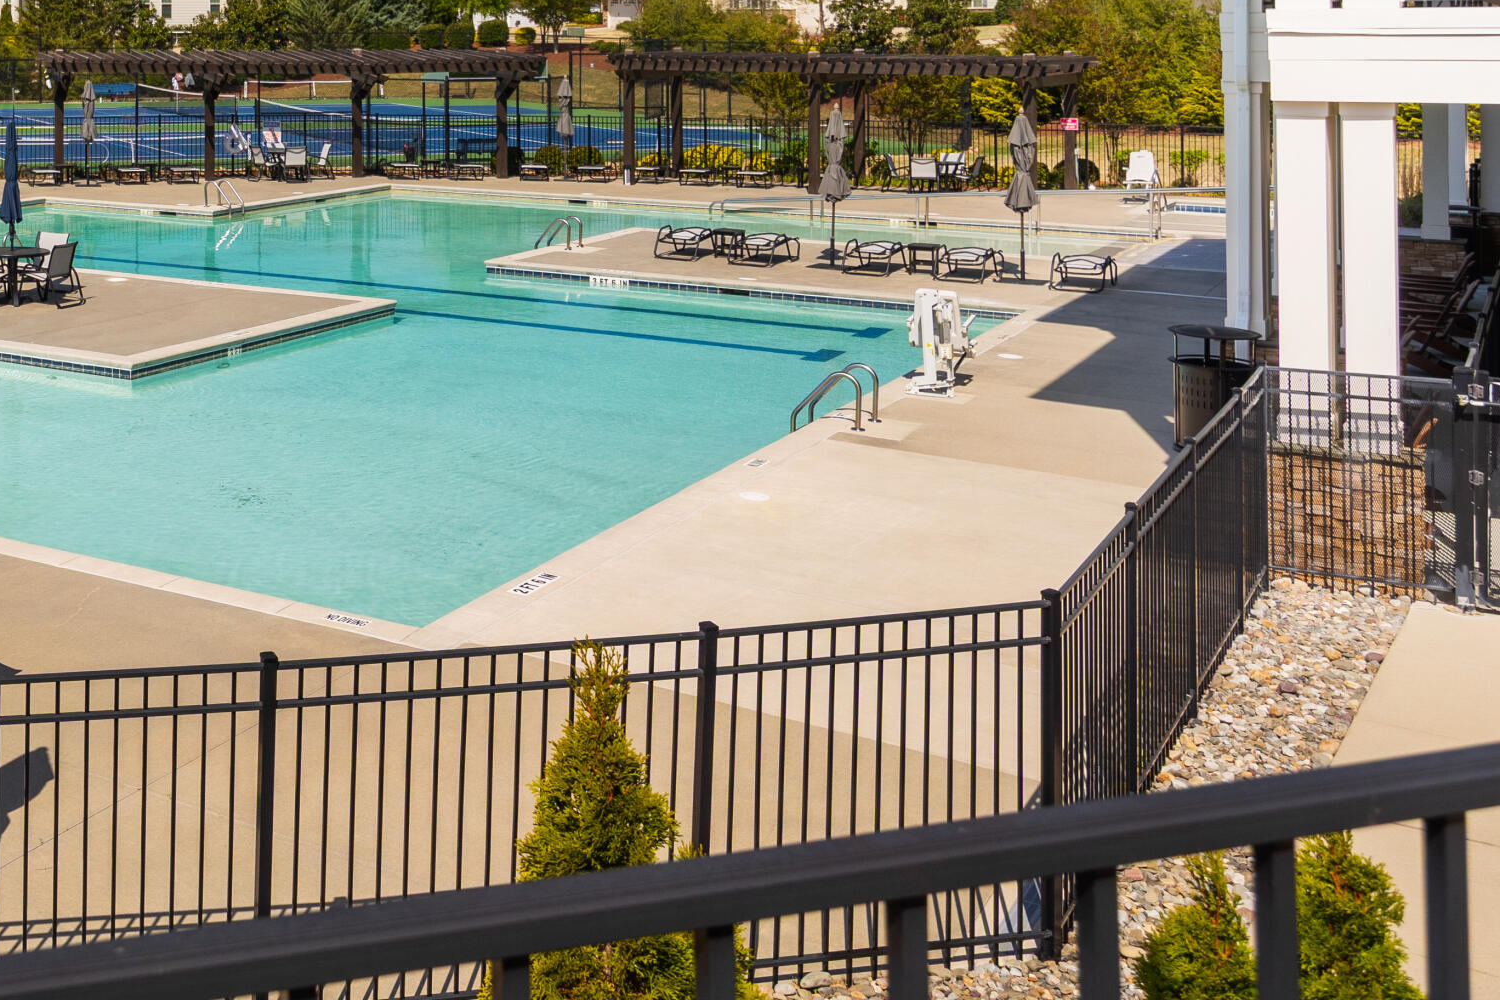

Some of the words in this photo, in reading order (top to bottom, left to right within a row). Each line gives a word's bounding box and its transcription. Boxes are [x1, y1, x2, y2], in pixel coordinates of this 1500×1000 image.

[519, 582, 540, 591] FT
[538, 572, 558, 581] IN
[325, 613, 341, 621] NO
[337, 616, 370, 627] DIVING
